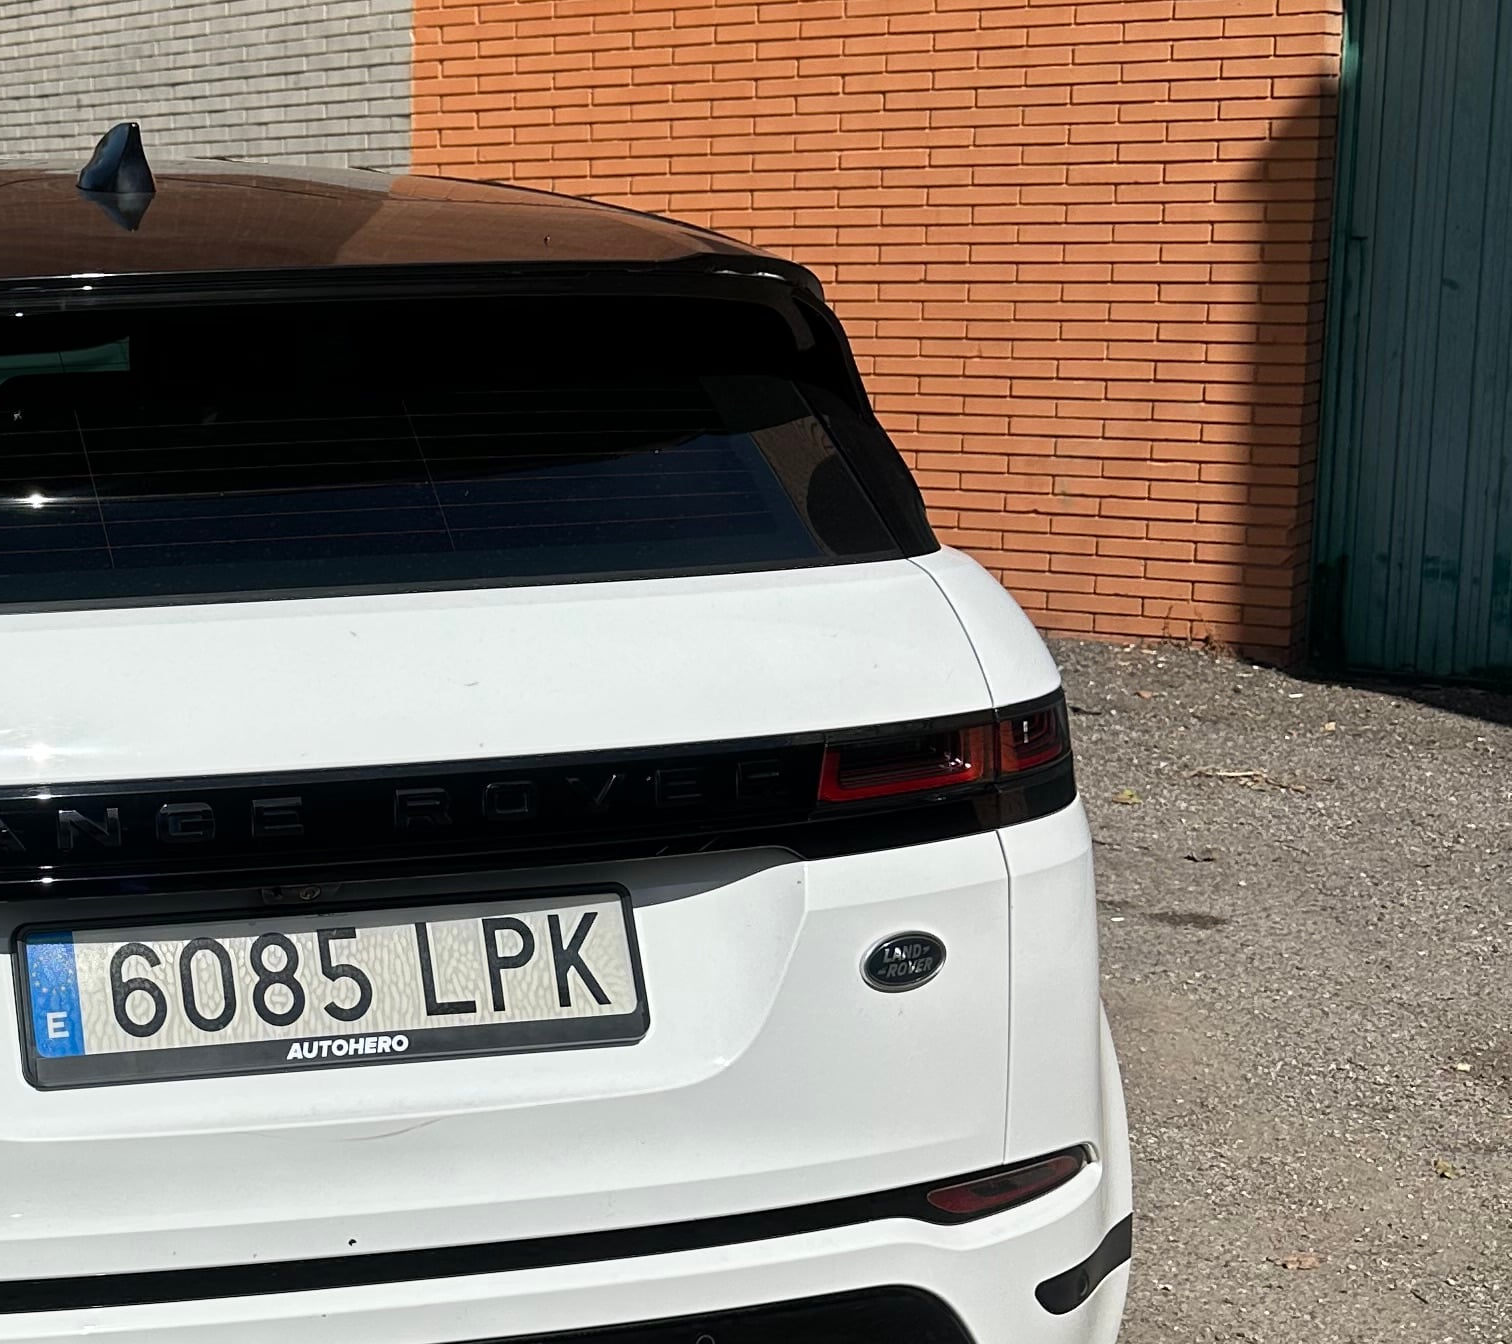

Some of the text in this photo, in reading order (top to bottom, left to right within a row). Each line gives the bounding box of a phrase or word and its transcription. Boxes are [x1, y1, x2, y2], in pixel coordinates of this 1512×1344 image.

[883, 944, 923, 964] LAND
[46, 911, 612, 1039] E 6085 LPK
[886, 957, 933, 978] ROVER
[286, 1034, 409, 1061] AUTOHERO
